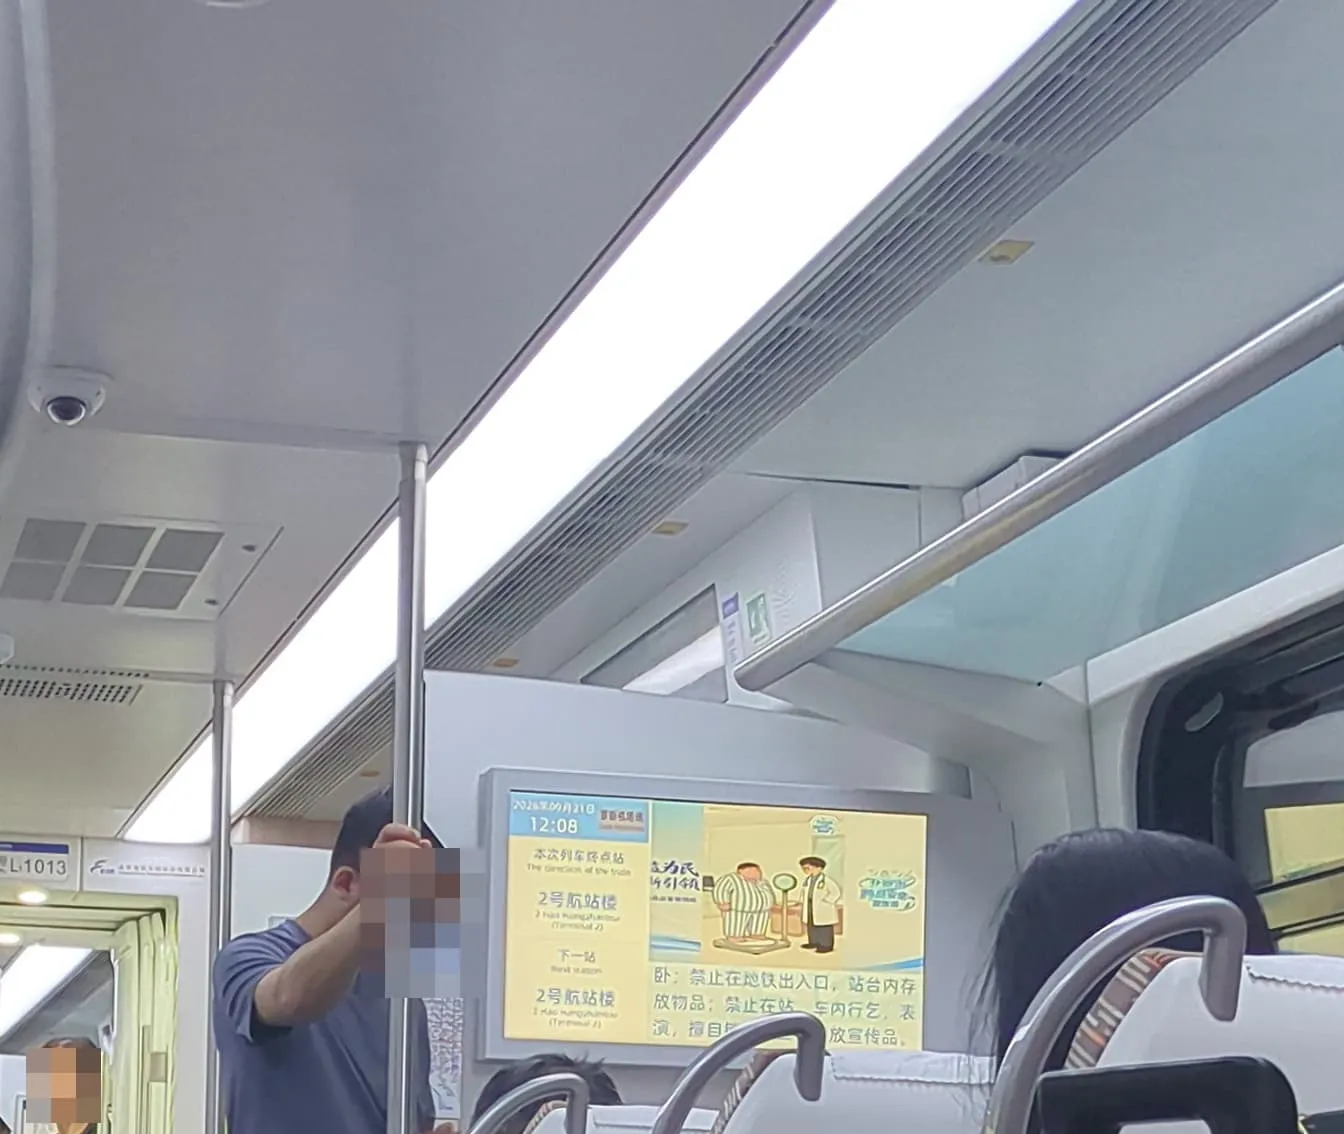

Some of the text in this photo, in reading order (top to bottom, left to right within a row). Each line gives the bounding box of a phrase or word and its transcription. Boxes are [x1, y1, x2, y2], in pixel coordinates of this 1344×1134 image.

[530, 817, 578, 833] 12:08
[534, 848, 624, 864] 本次列车终点站
[539, 891, 617, 911] 2号航站楼
[558, 949, 596, 964] 下一站
[536, 987, 615, 1008] 2号航站楼
